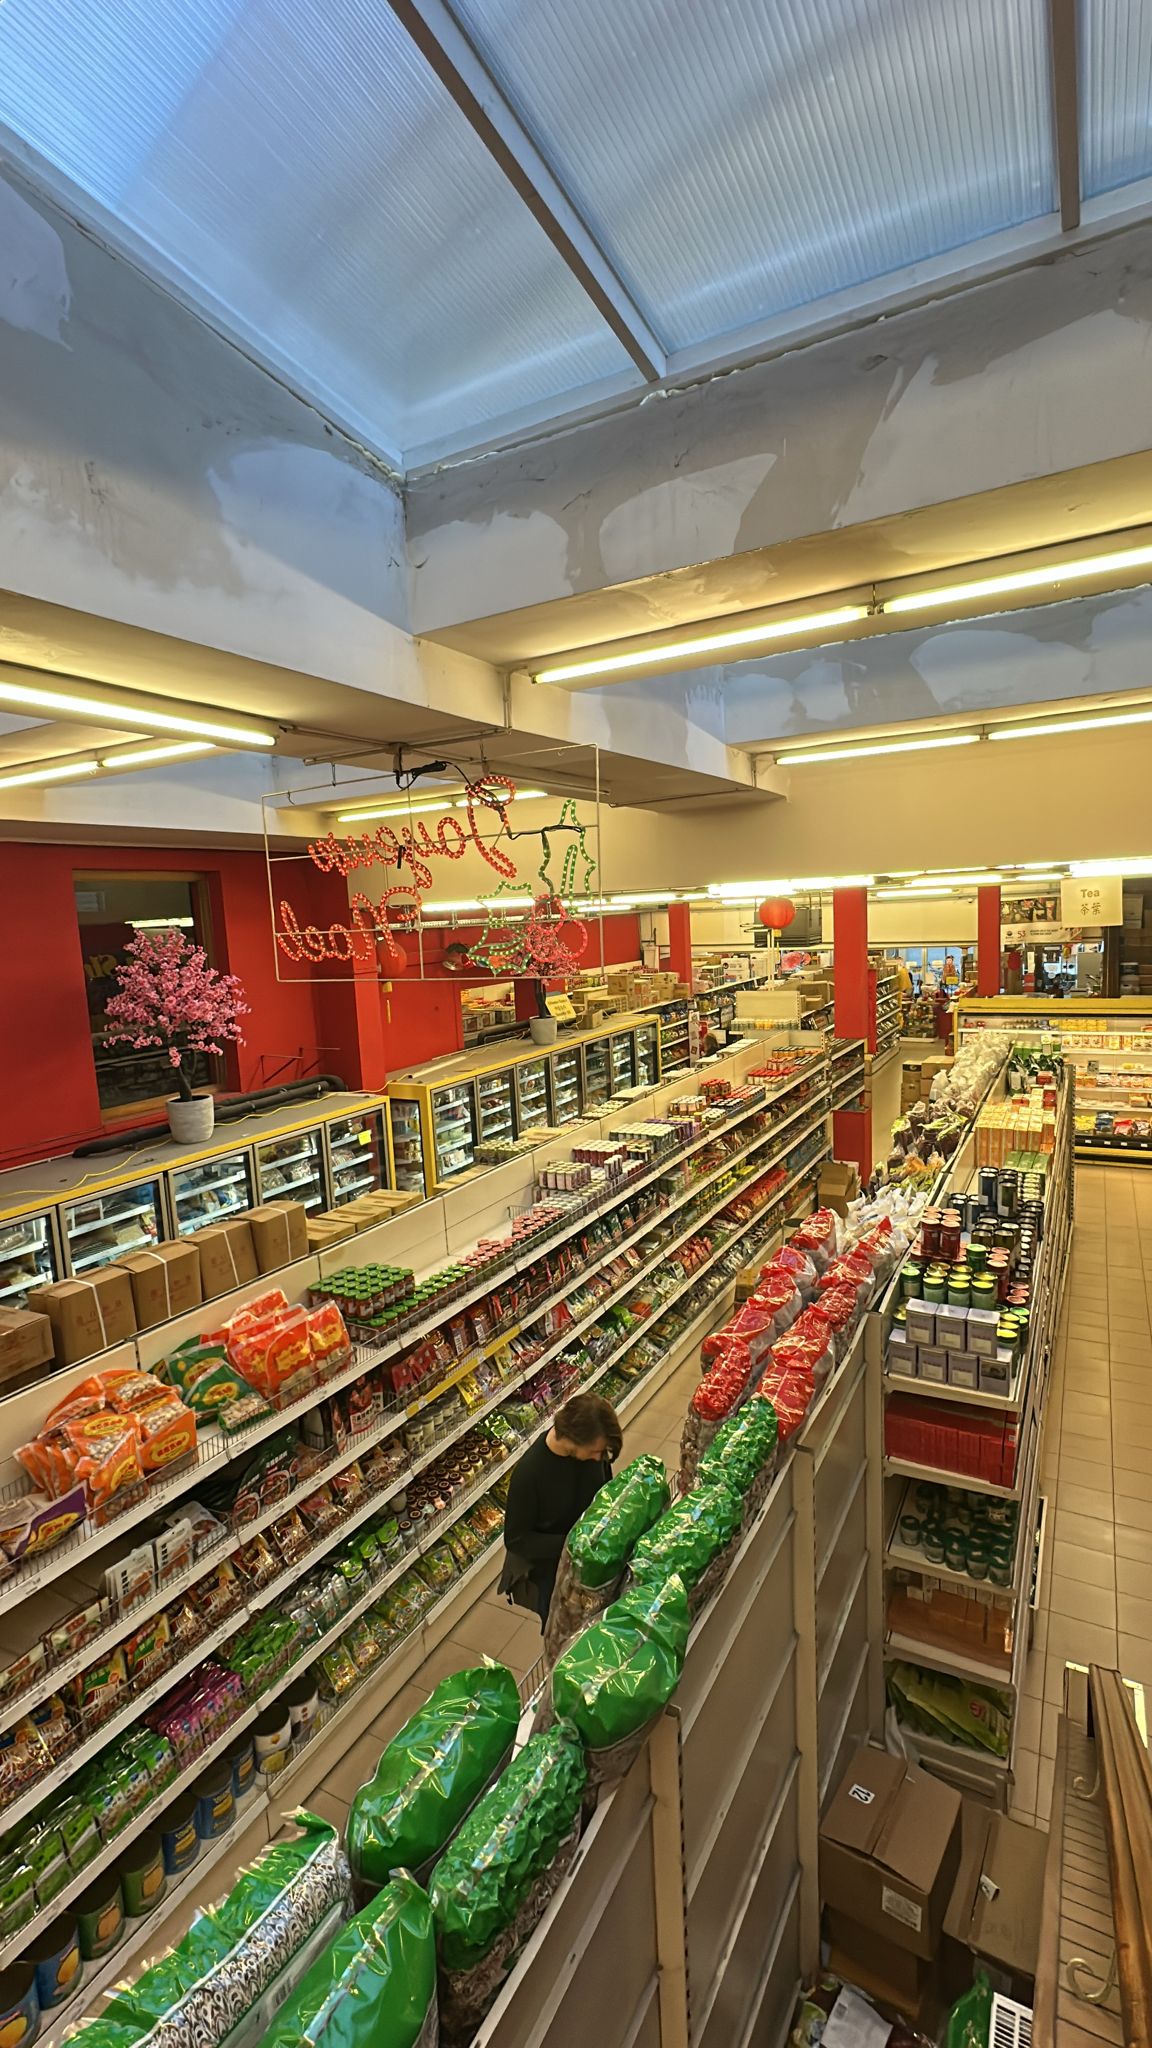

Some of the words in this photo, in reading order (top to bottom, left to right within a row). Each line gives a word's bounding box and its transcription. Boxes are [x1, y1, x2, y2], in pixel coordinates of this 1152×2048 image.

[1080, 889, 1100, 898] Tea
[1080, 902, 1102, 916] 茶葉
[852, 1787, 871, 1802] 12
